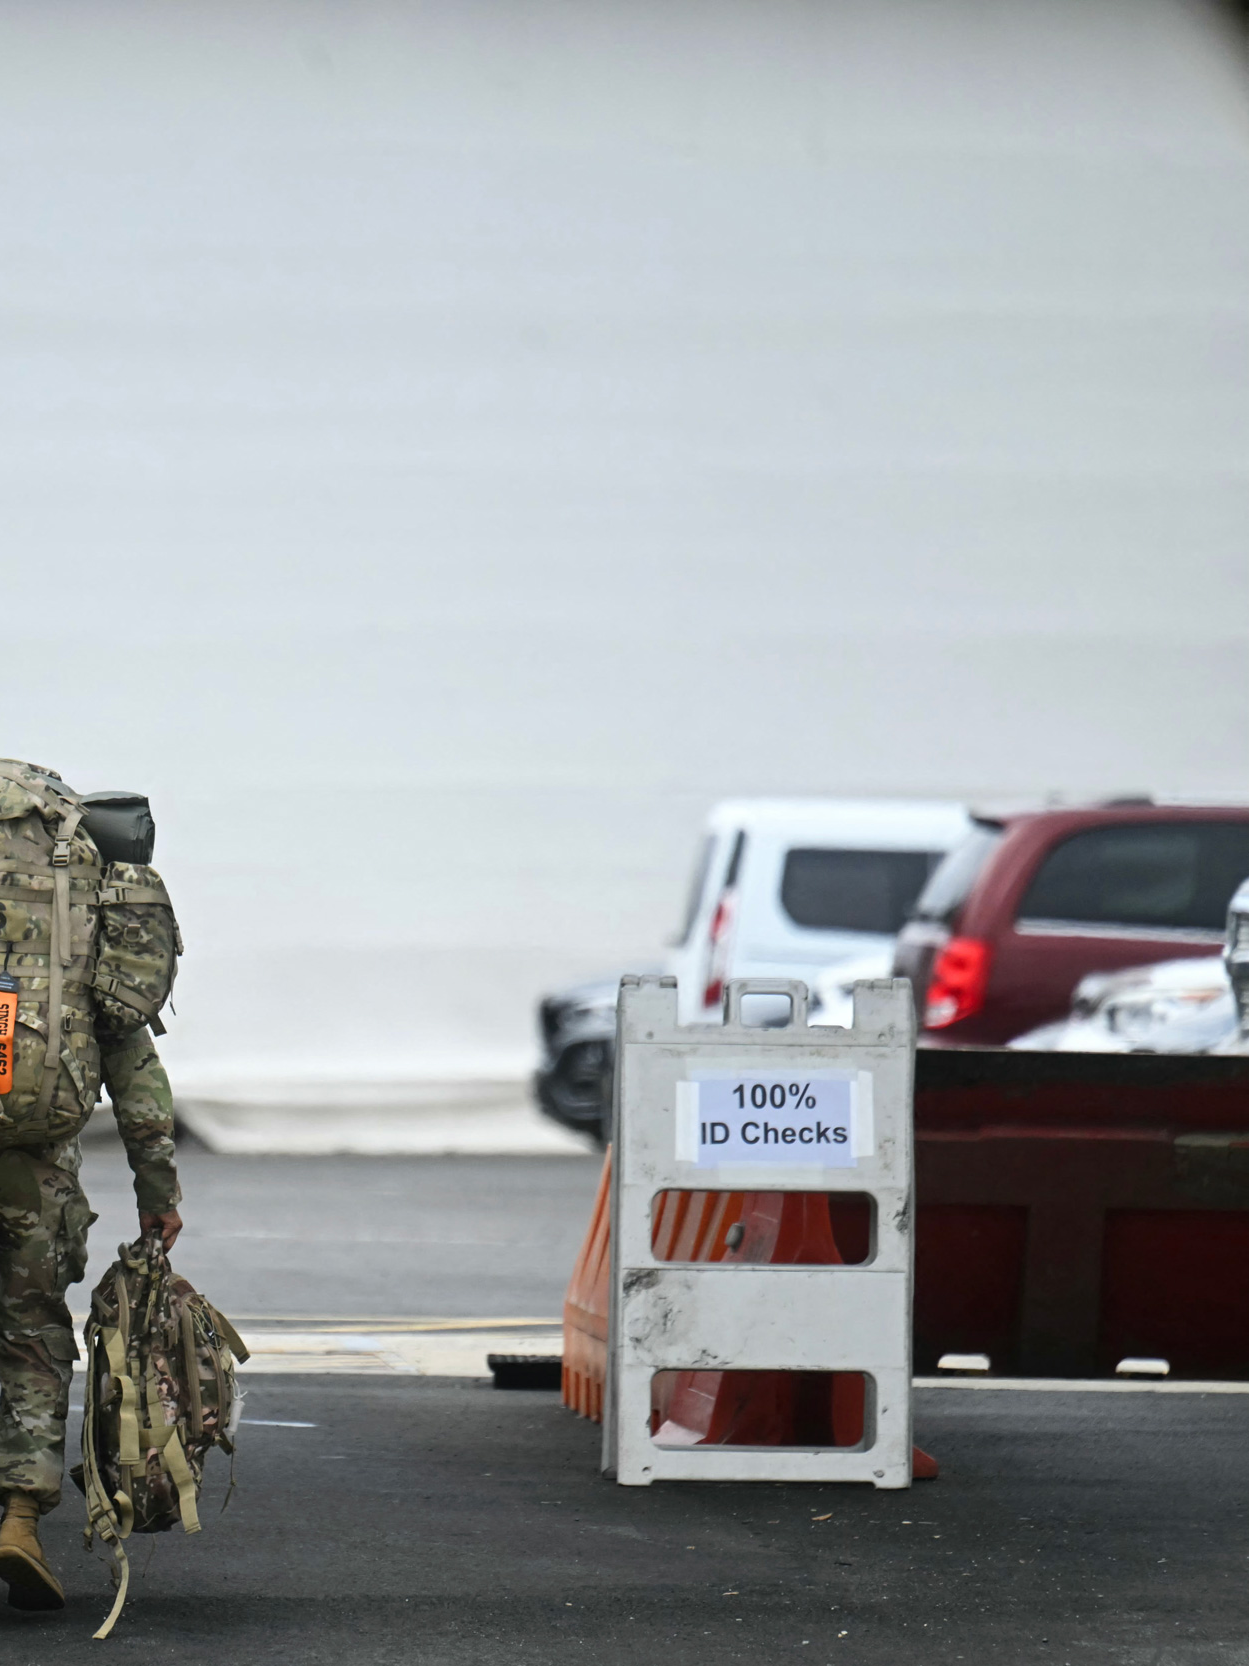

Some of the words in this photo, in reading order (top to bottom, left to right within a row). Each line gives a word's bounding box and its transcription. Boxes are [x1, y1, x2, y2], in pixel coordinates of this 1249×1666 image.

[732, 1083, 817, 1109] 100%
[701, 1122, 730, 1145] ID
[740, 1121, 848, 1144] Checks
